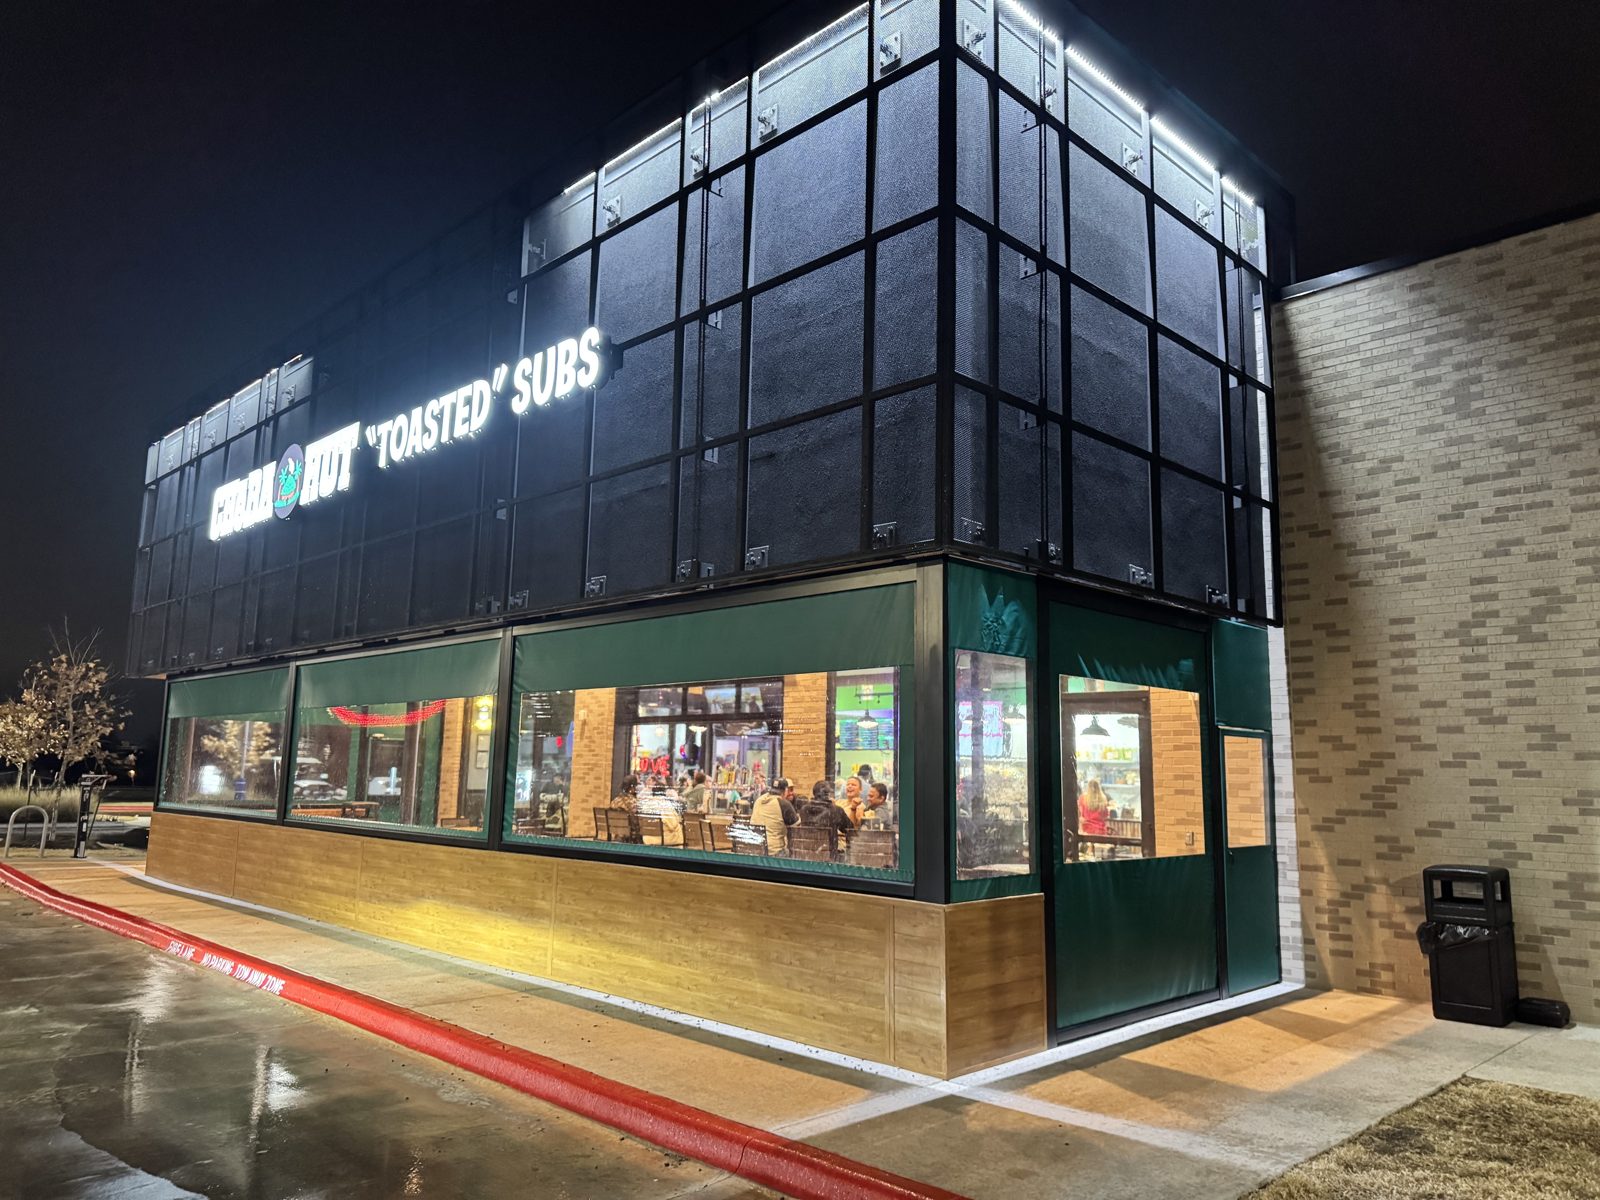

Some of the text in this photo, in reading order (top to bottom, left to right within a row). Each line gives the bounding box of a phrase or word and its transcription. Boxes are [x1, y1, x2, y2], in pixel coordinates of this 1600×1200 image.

[299, 422, 360, 505] HUT
[511, 326, 600, 415] SUBS
[166, 941, 286, 995] FIRE LANE NO PARKING TOW AWAY ZONE
